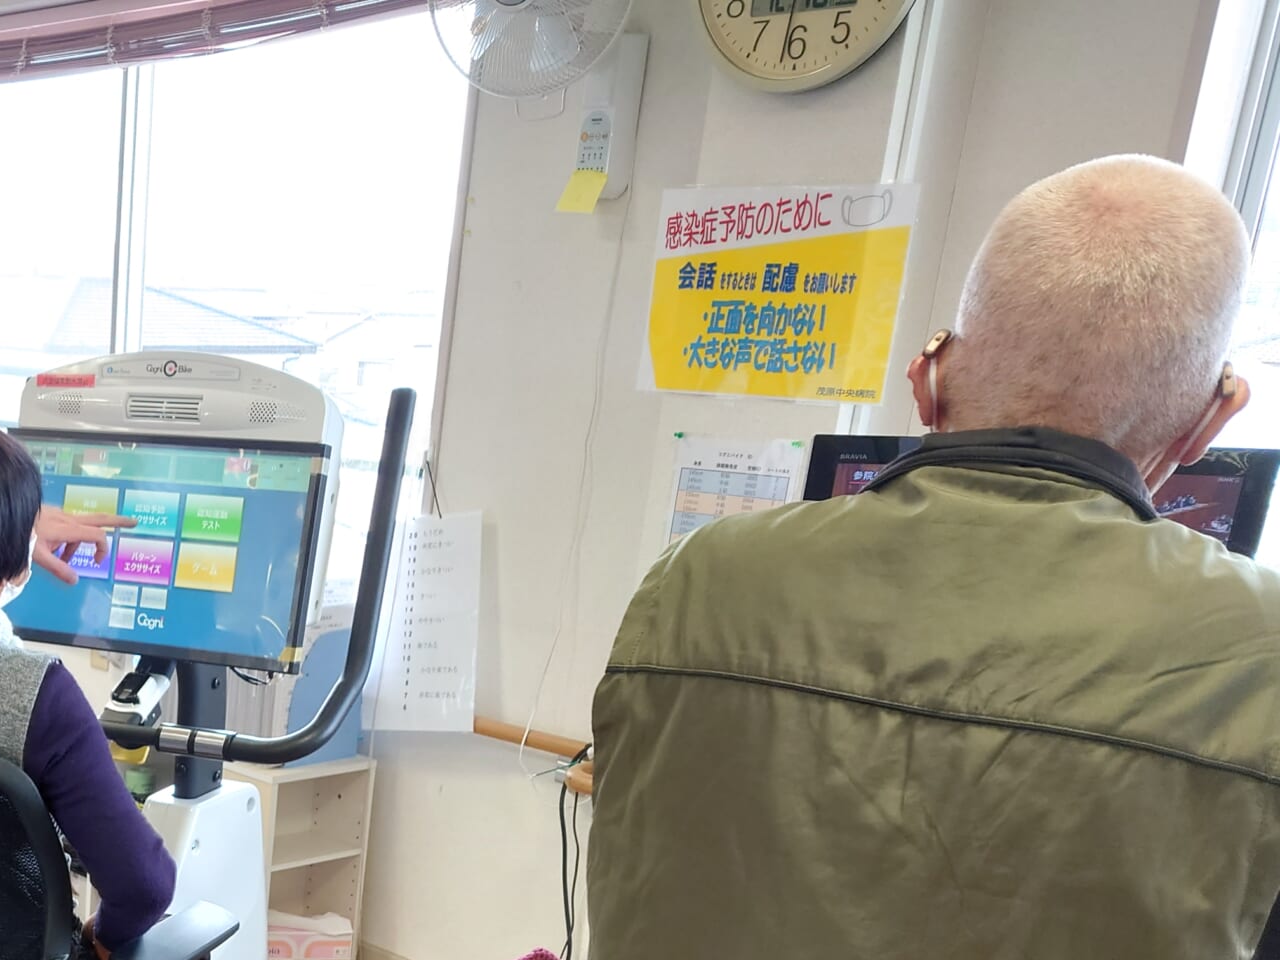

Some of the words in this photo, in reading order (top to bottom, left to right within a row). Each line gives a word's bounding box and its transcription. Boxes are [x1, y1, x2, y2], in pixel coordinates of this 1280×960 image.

[752, 20, 771, 52] 7
[786, 25, 808, 59] 6
[830, 10, 852, 44] 5
[665, 193, 833, 249] 感染症予防のために
[678, 261, 717, 290] 会話
[720, 271, 757, 291] をするときは
[761, 262, 799, 293] 配慮
[803, 272, 857, 294] をお願いします
[853, 470, 879, 481] 参院
[124, 562, 162, 575] エクササイズ
[137, 612, 164, 630] Cogni
